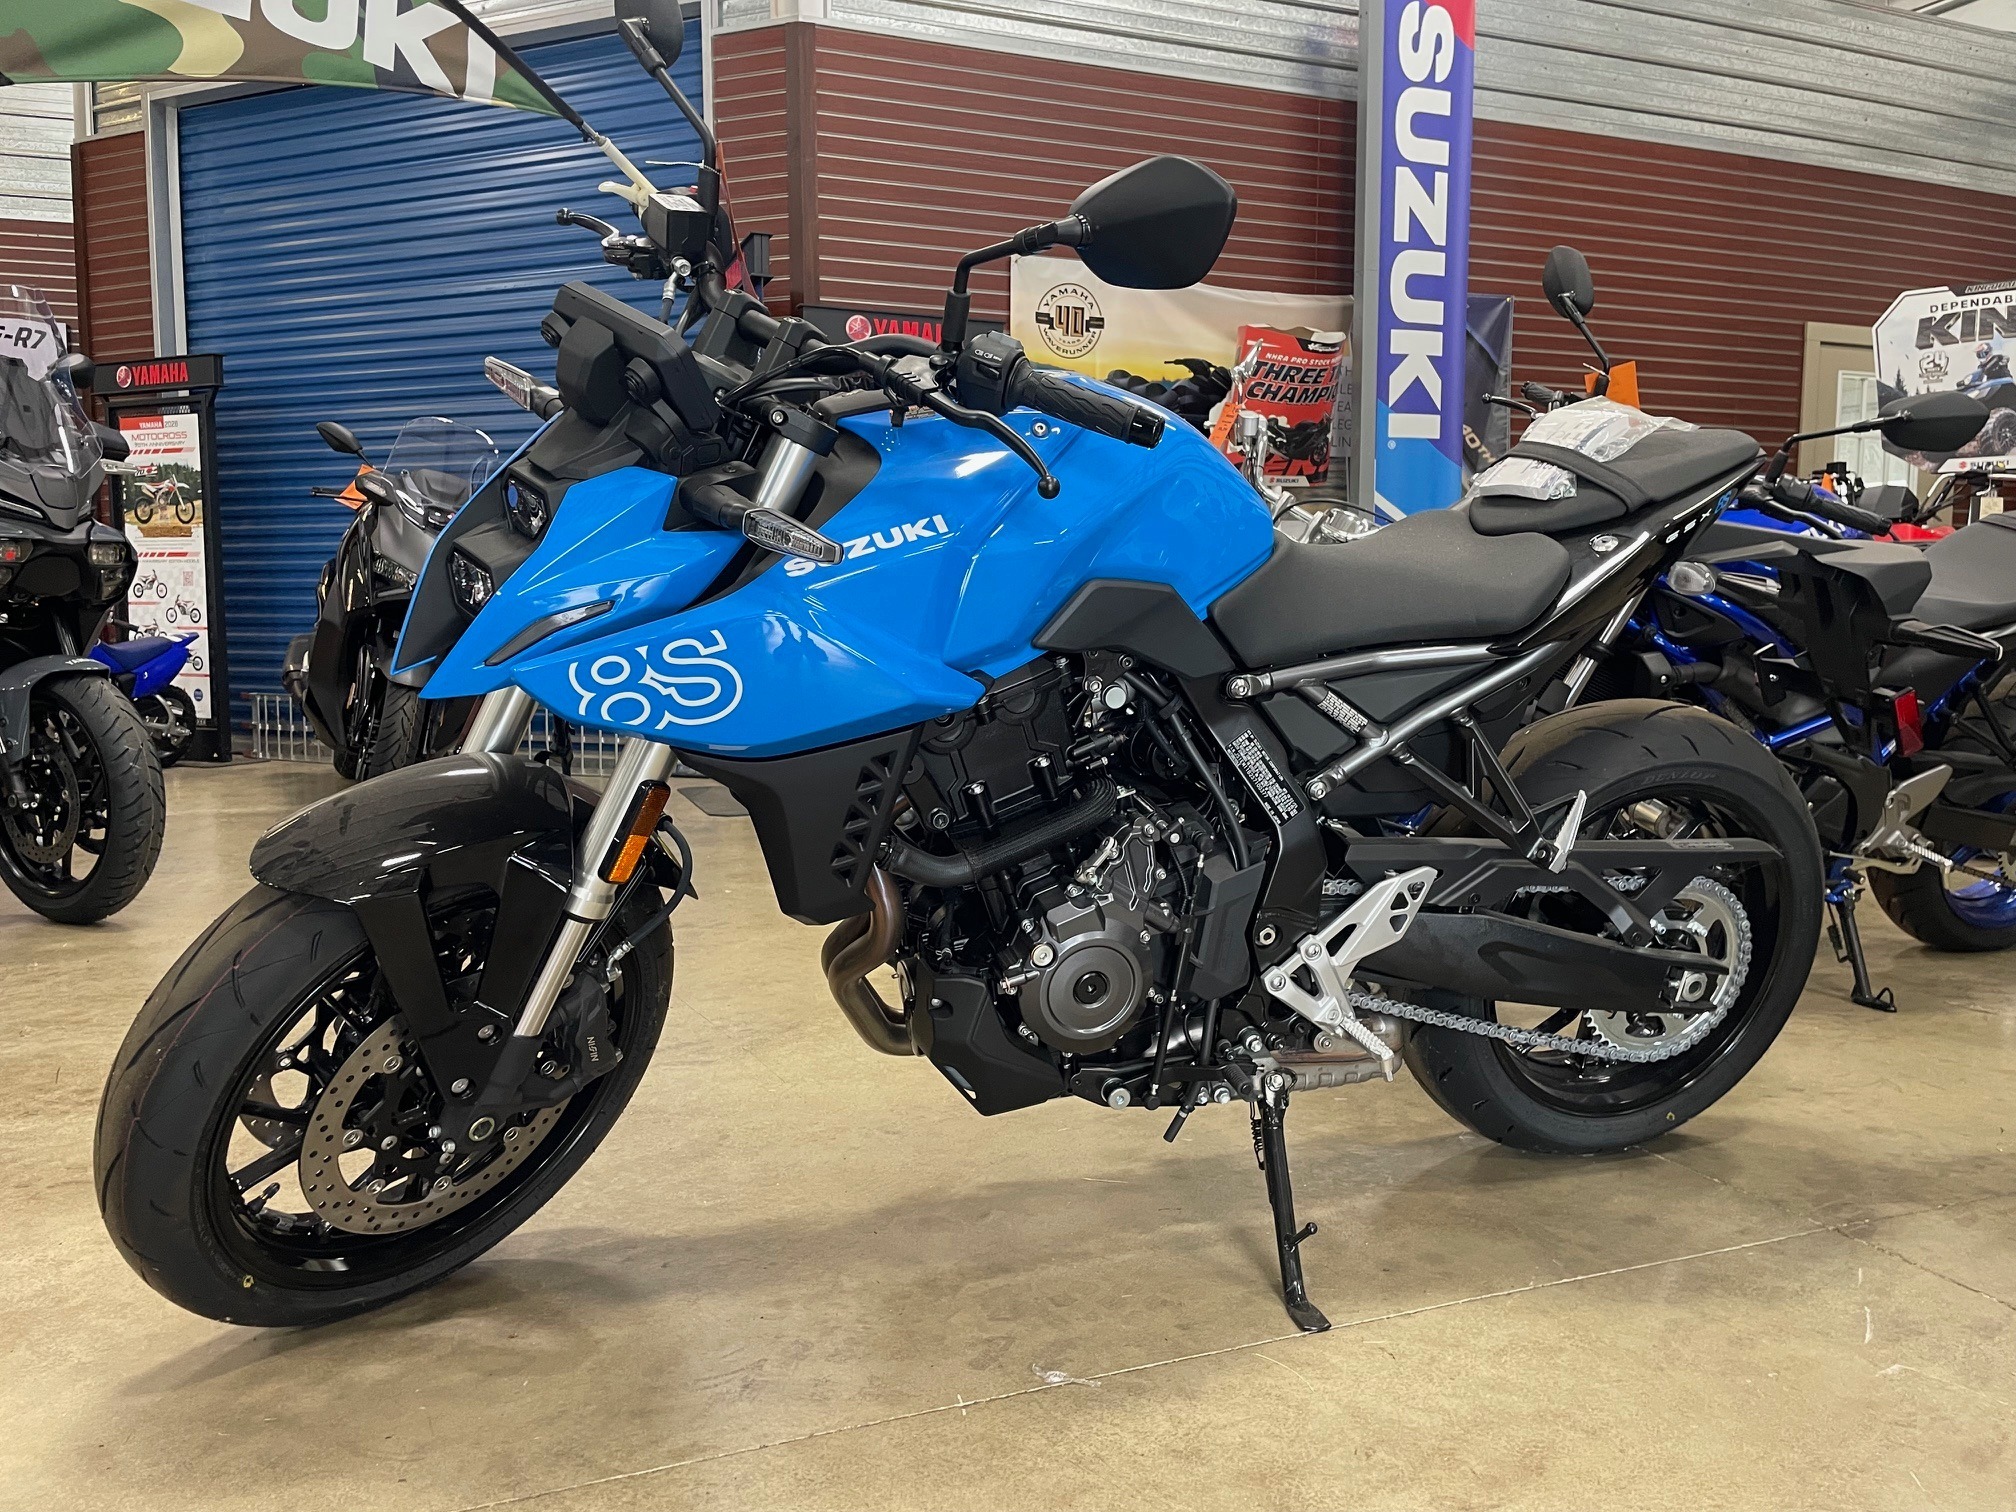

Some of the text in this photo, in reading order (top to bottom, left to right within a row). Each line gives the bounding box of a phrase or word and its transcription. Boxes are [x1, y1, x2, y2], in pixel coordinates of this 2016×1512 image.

[184, 0, 496, 98] UKI
[1388, 1, 1455, 438] SUZUKI
[1043, 288, 1094, 310] YAMAHA
[1930, 294, 2016, 314] DEPENDAB
[873, 318, 942, 344] YAMA
[1055, 305, 1085, 338] 40
[1043, 328, 1097, 355] WAVERUNNER
[1265, 352, 1289, 362] NHRA
[1291, 356, 1308, 365] PRO
[132, 361, 188, 386] YAMAHA
[1254, 361, 1328, 384] THREE
[131, 431, 188, 442] MOTOCROSS
[139, 421, 163, 430] YAMAHA
[783, 514, 949, 578] SZUKI
